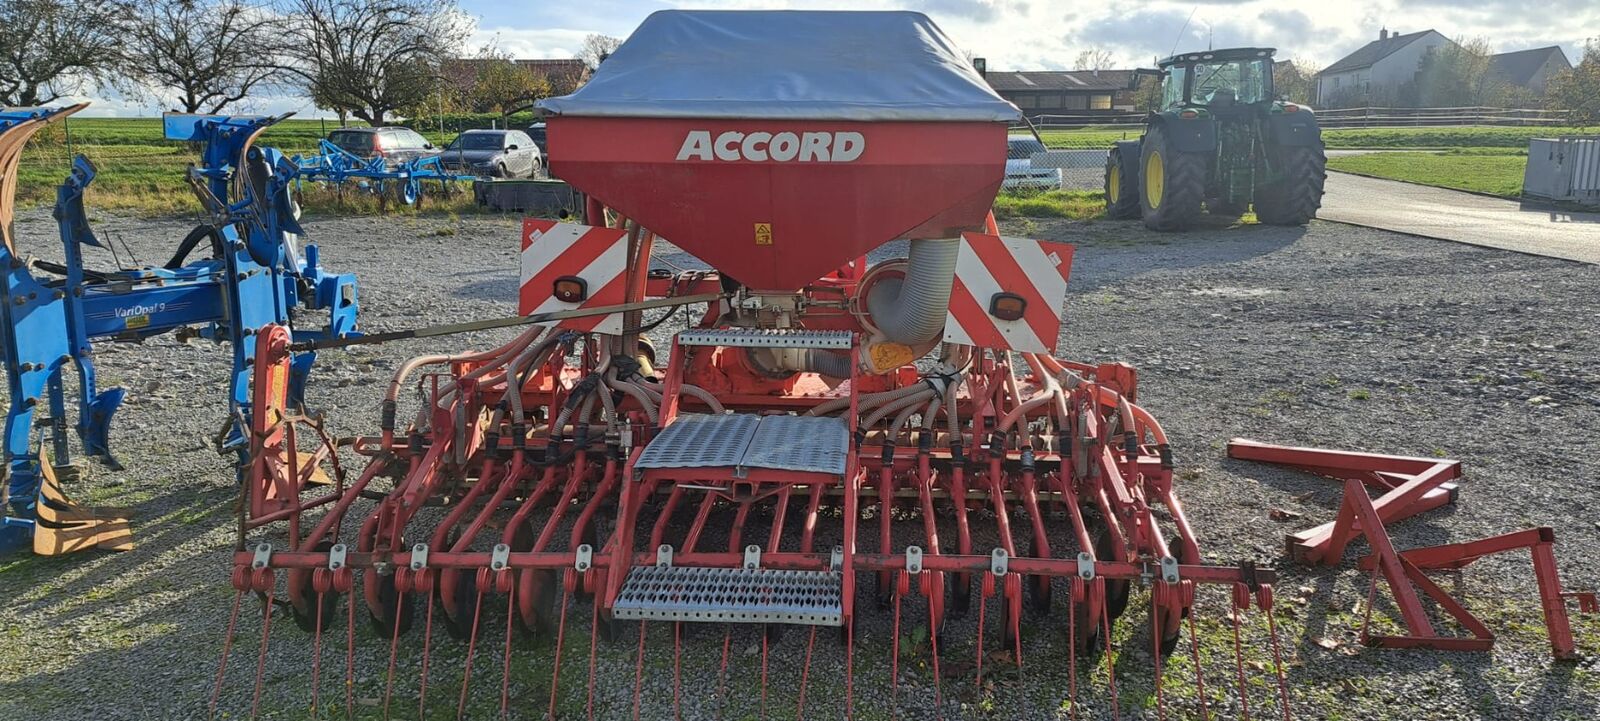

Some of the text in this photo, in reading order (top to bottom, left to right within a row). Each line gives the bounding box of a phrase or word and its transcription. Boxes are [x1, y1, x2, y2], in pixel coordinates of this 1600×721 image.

[676, 130, 865, 162] ACCORD
[114, 302, 166, 317] VariOpal 9
